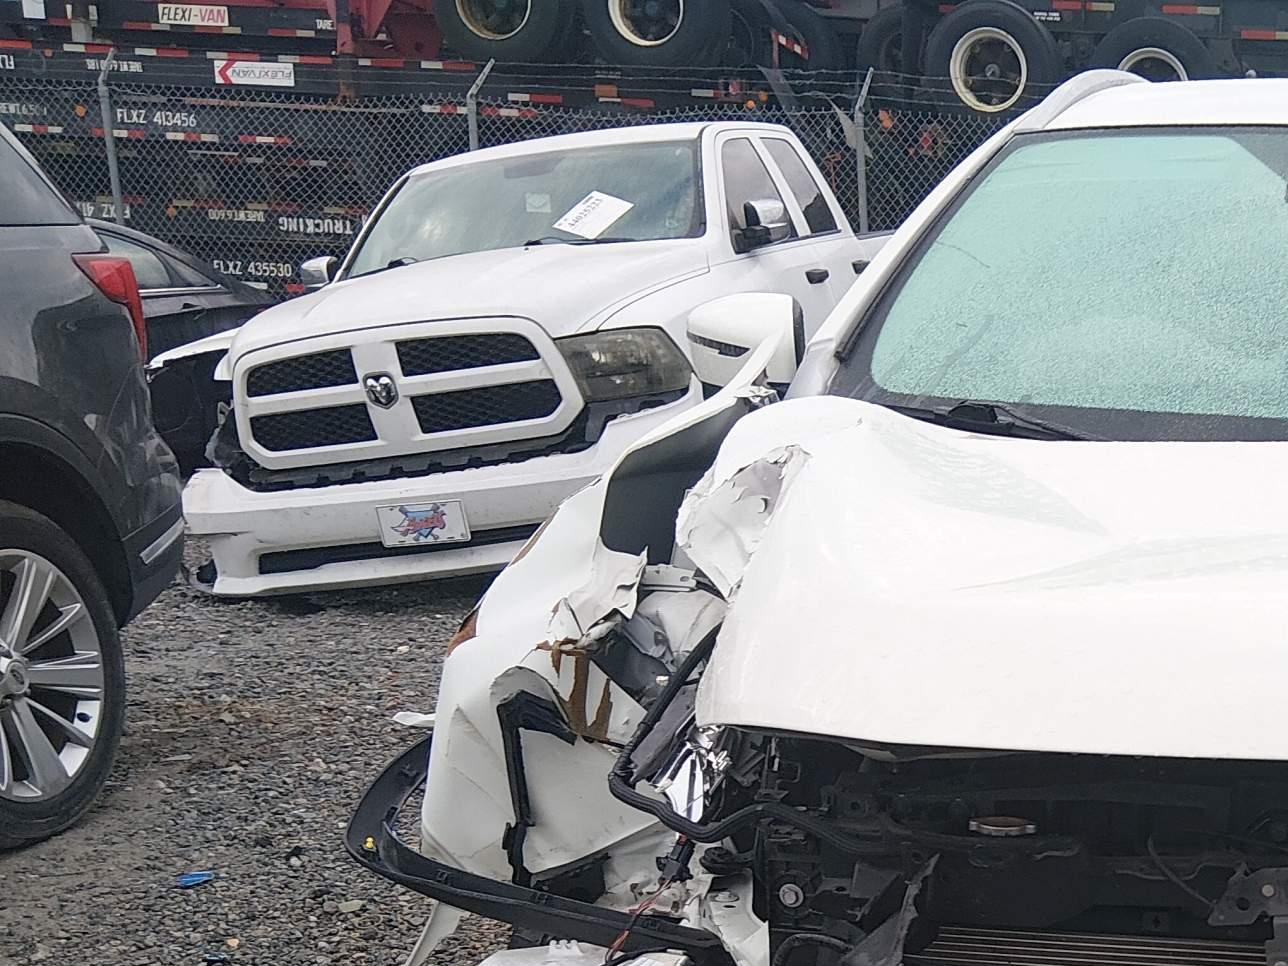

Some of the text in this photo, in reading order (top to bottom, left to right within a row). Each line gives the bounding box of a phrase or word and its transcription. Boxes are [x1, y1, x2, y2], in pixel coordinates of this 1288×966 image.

[161, 6, 226, 24] FLEXI-VAN
[116, 108, 197, 128] FLXZ 413456
[279, 216, 353, 234] TRUCKING
[247, 261, 293, 277] 435530
